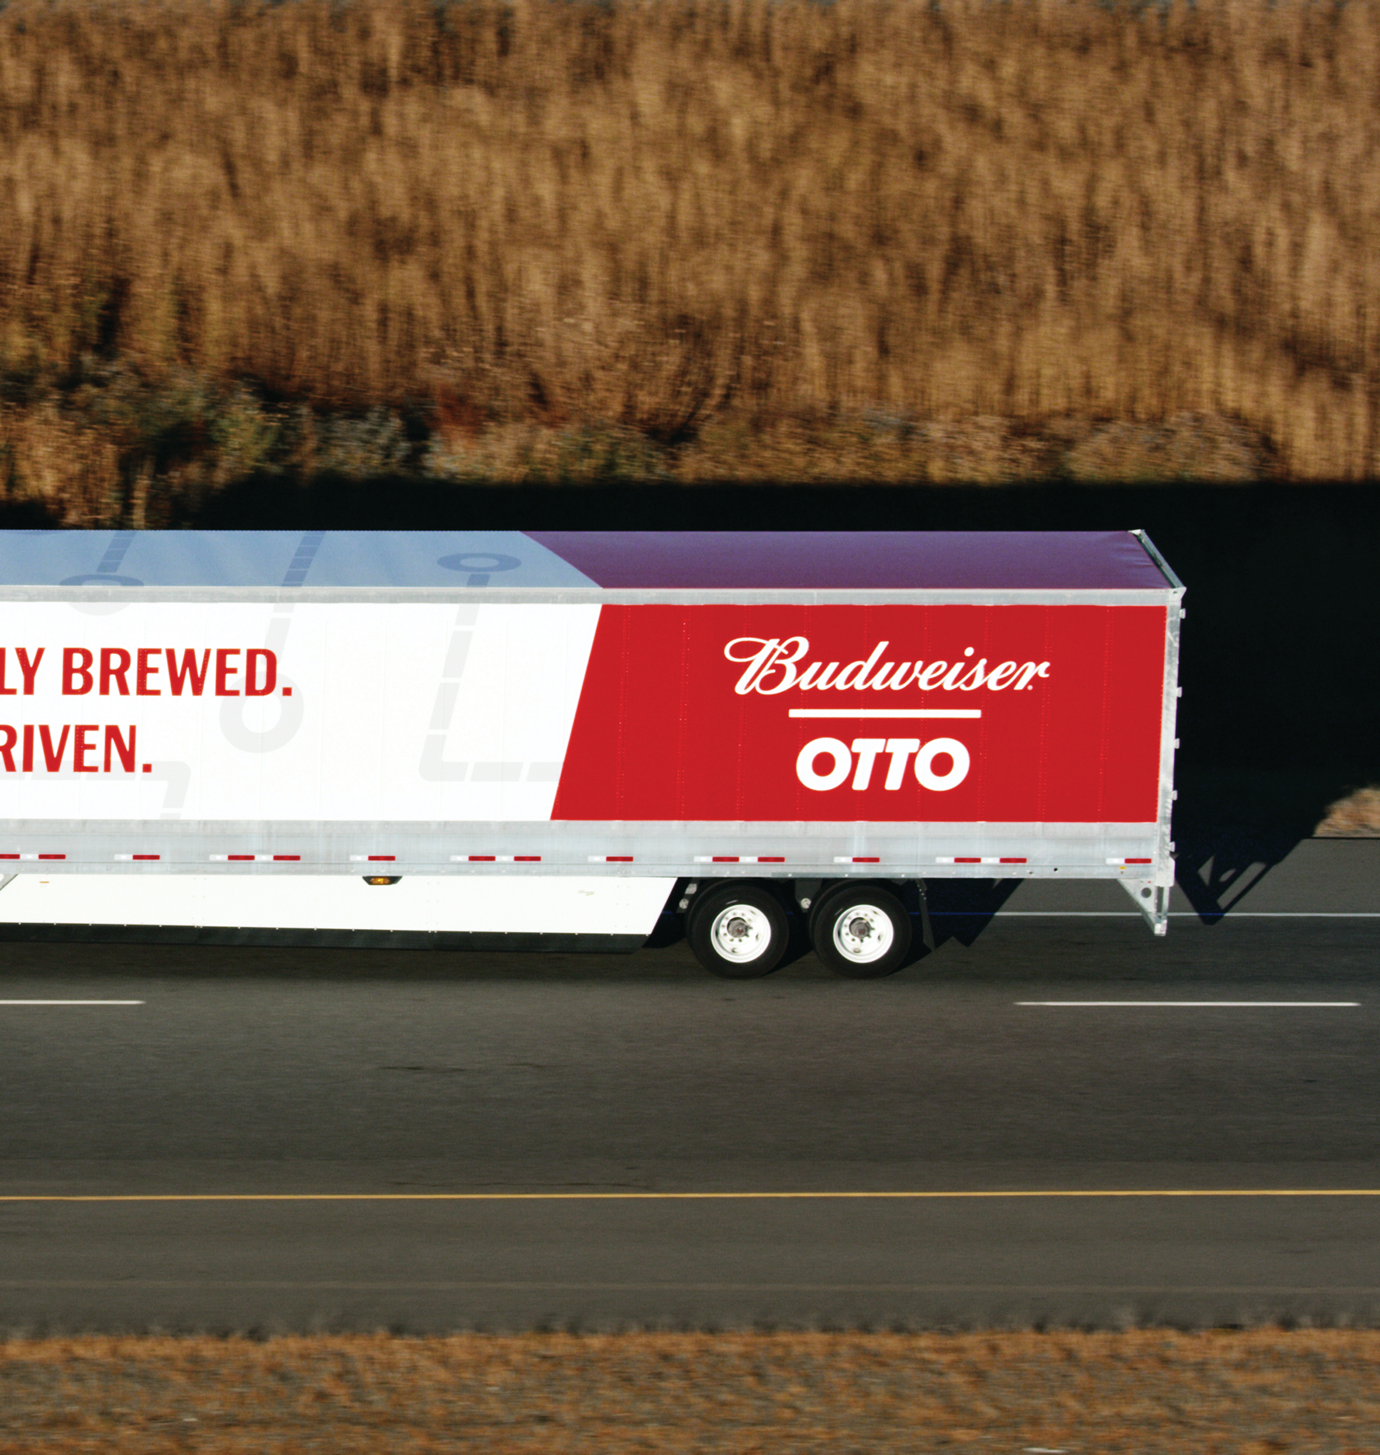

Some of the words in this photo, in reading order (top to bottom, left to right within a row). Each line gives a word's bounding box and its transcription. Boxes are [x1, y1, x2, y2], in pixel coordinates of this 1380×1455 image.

[61, 647, 293, 697] BREWED.
[724, 636, 1050, 696] Budweiser
[796, 737, 970, 792] OTTO
